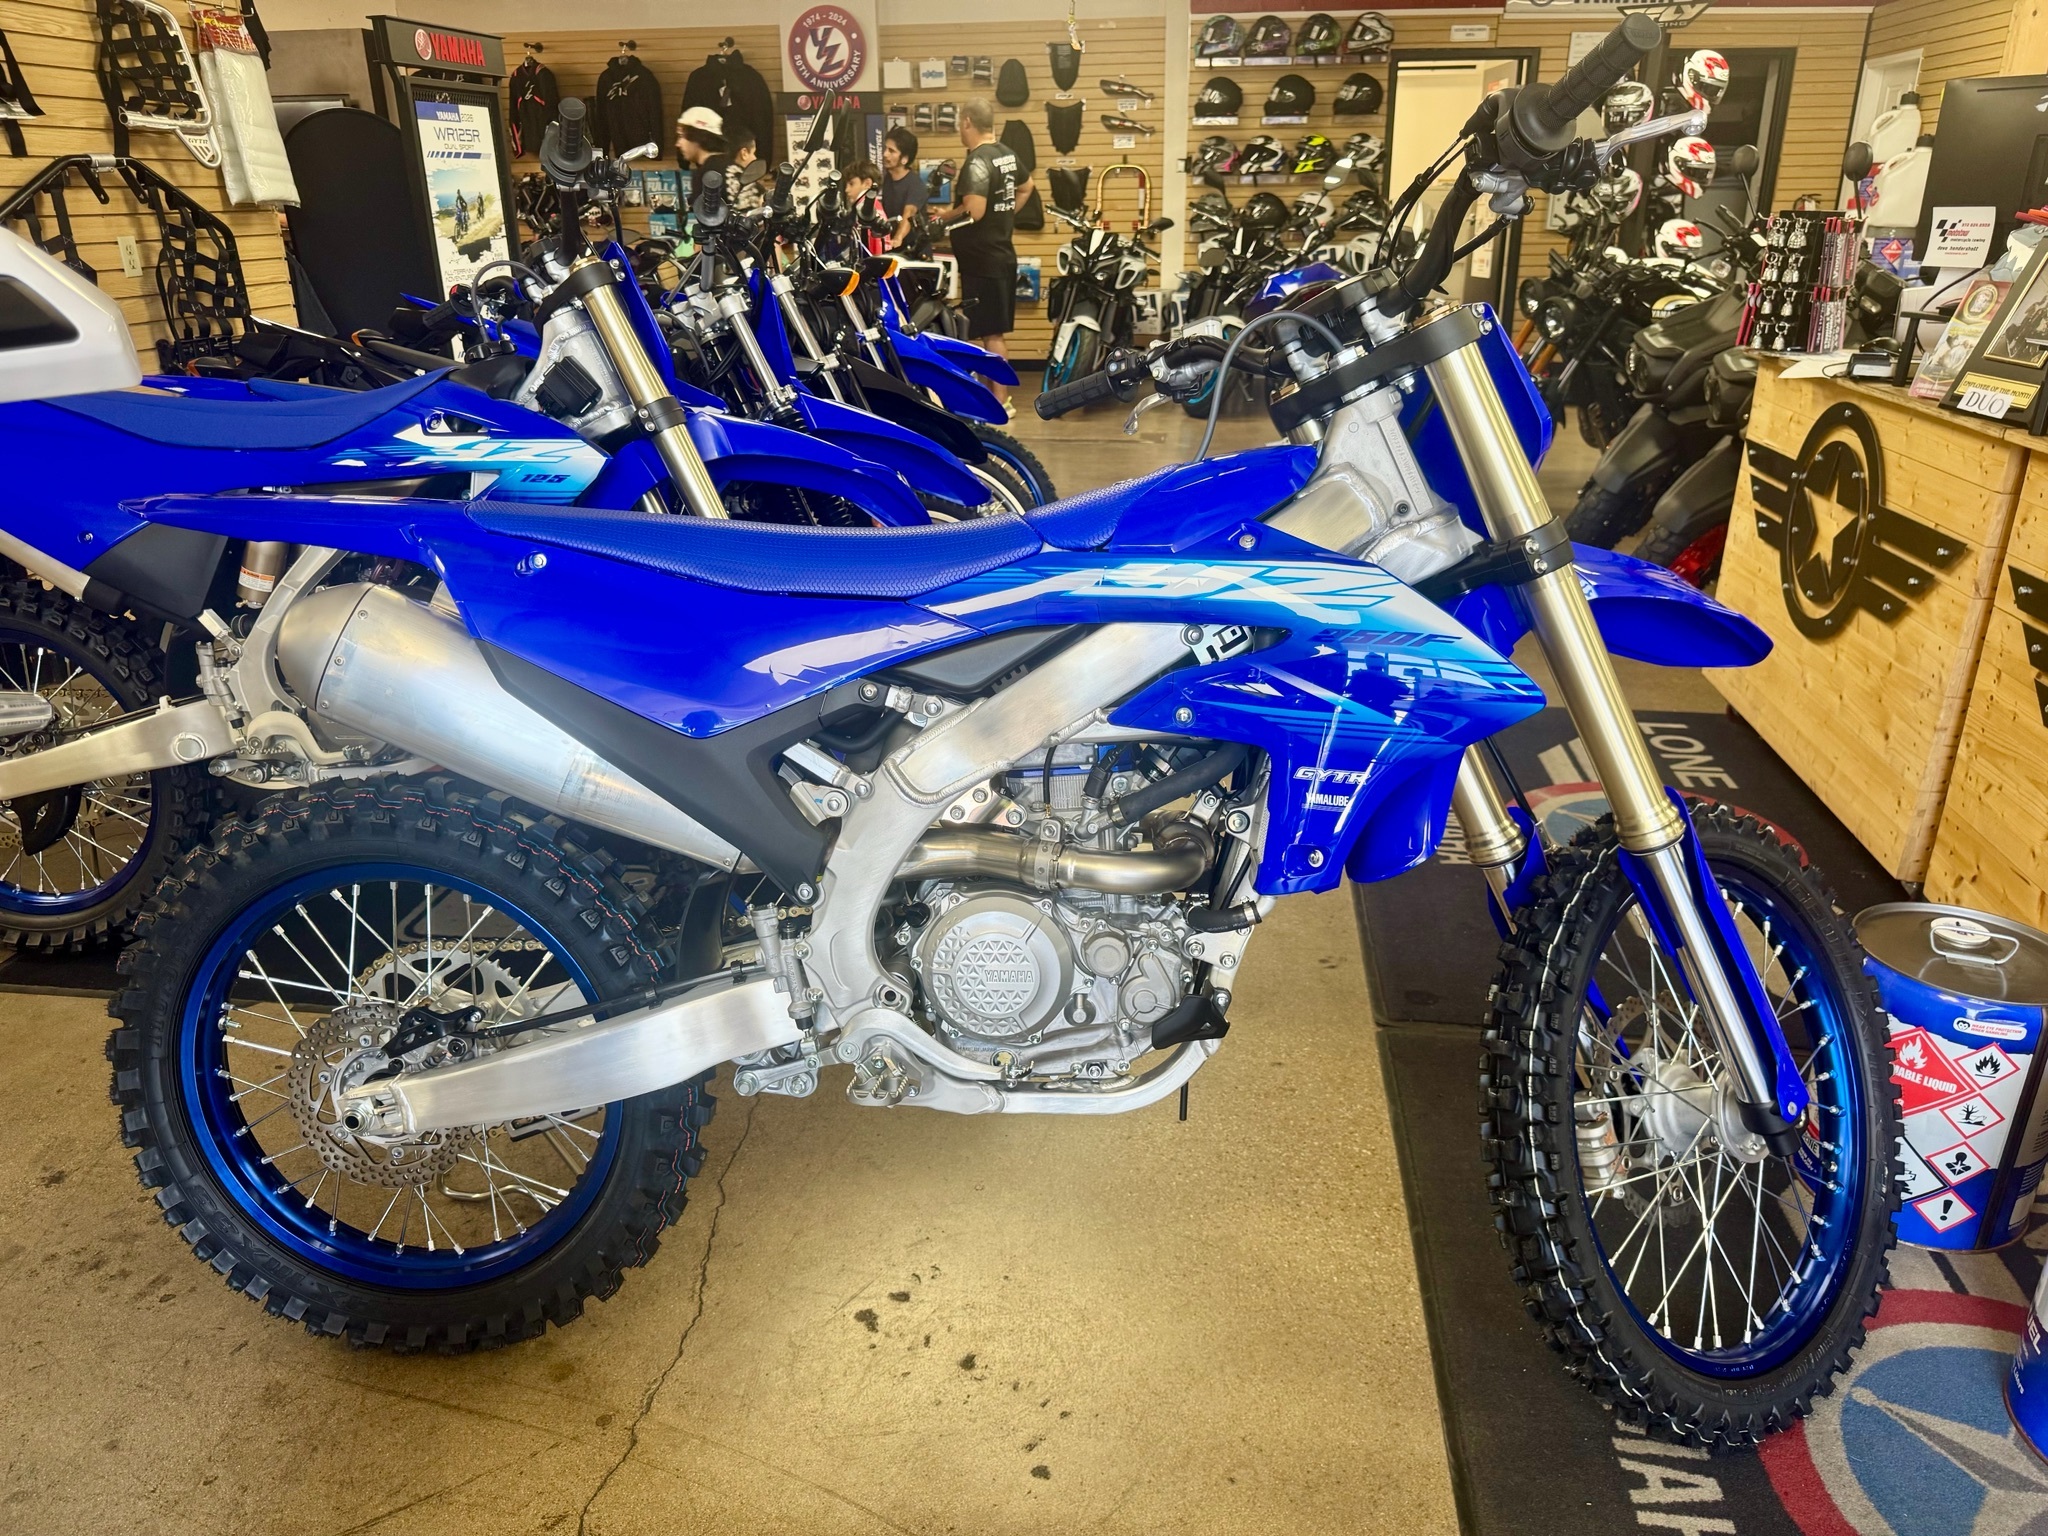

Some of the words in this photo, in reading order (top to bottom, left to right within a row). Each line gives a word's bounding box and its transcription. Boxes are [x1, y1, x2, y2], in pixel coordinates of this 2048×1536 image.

[803, 13, 820, 28] 1974
[829, 12, 847, 26] 2024
[430, 32, 486, 67] YAMAHA
[809, 27, 845, 74] YZ
[794, 54, 810, 78] 50TH
[810, 50, 861, 89] ANNIVERSARY
[436, 111, 460, 121] YAMAHA
[433, 127, 481, 143] WR125R
[1963, 380, 1991, 391] EMPLOYEE
[2011, 390, 2032, 400] MONTH
[1965, 391, 2005, 415] DUO
[520, 473, 571, 483] 125
[1306, 628, 1463, 647] 250F
[1638, 721, 1740, 790] LONE
[1293, 766, 1371, 785] GYTR
[1306, 792, 1350, 807] YAMALUBE
[985, 969, 1034, 983] YAMAHA
[1893, 1063, 1923, 1085] MABLE
[1923, 1076, 1957, 1094] LIQUID
